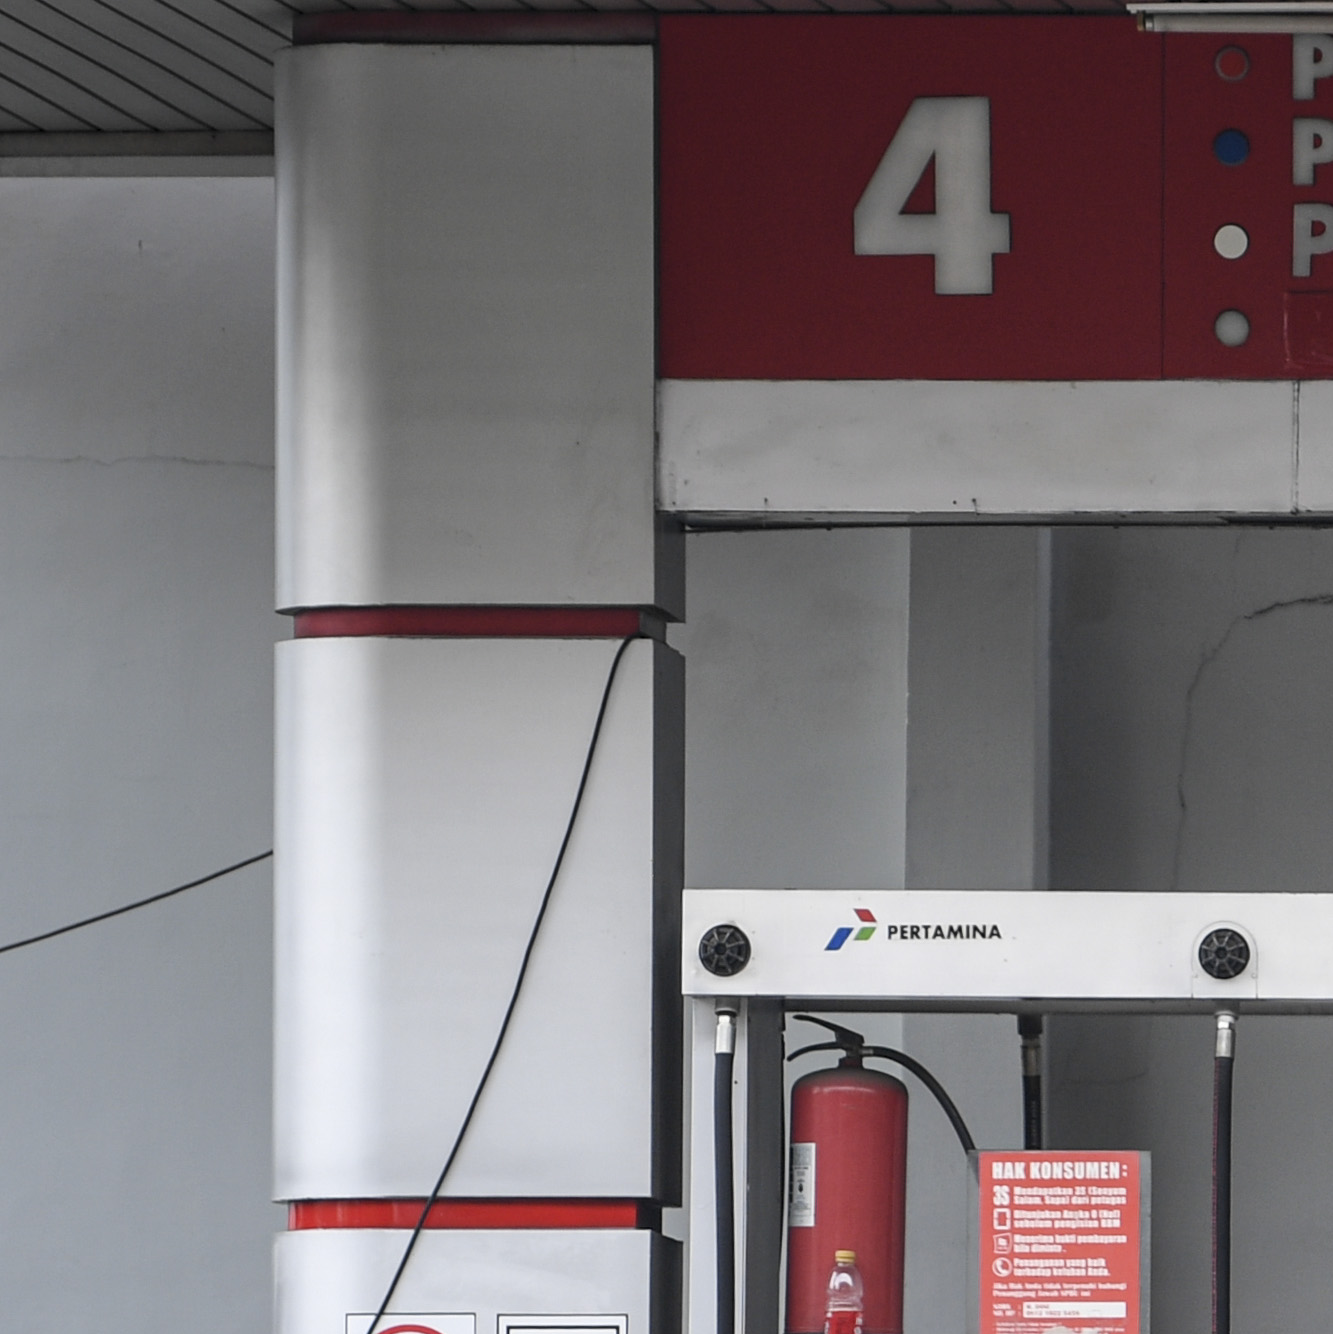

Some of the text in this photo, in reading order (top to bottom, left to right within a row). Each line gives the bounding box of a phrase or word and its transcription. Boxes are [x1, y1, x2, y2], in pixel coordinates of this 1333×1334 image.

[853, 96, 1011, 295] 4
[887, 924, 1002, 940] PERTAMINA
[992, 1162, 1026, 1179] HAK
[993, 1185, 1010, 1206] 3S
